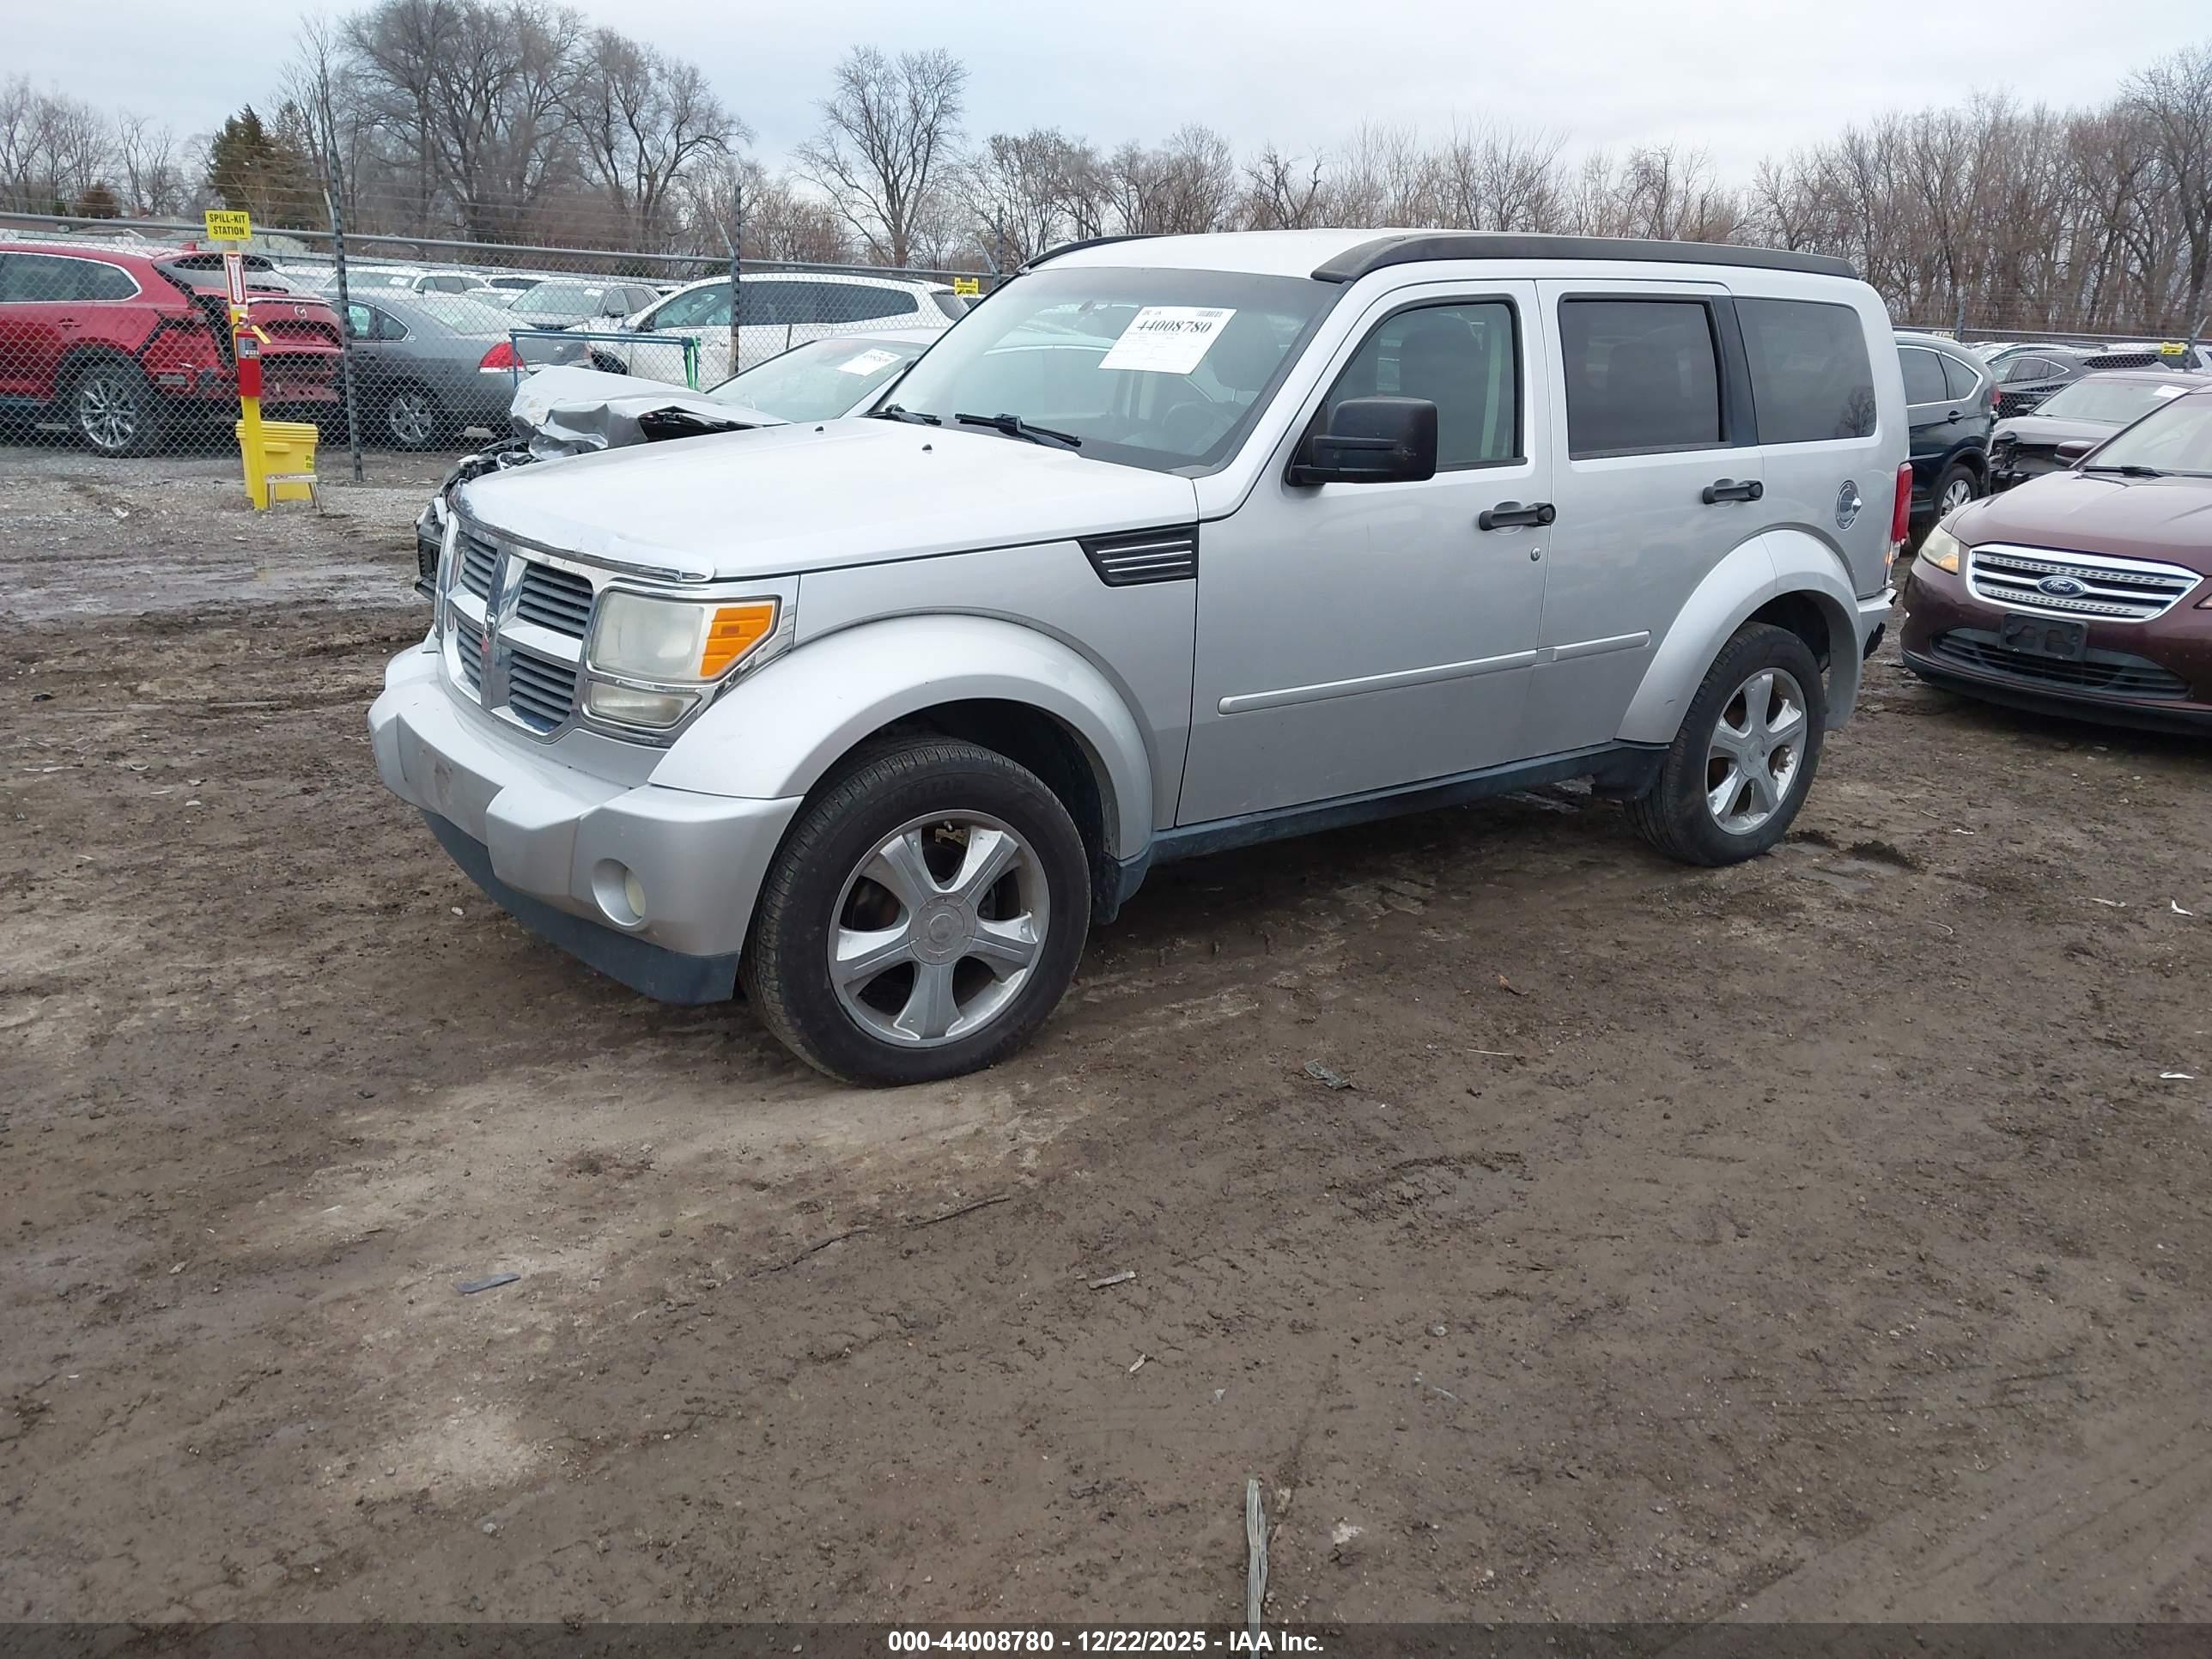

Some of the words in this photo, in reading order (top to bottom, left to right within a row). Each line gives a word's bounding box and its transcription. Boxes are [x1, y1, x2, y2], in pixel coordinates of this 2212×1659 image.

[209, 213, 246, 223] SPILL-KIT
[213, 225, 245, 235] STATION
[1137, 319, 1212, 334] 44008780
[2046, 580, 2073, 592] Ford
